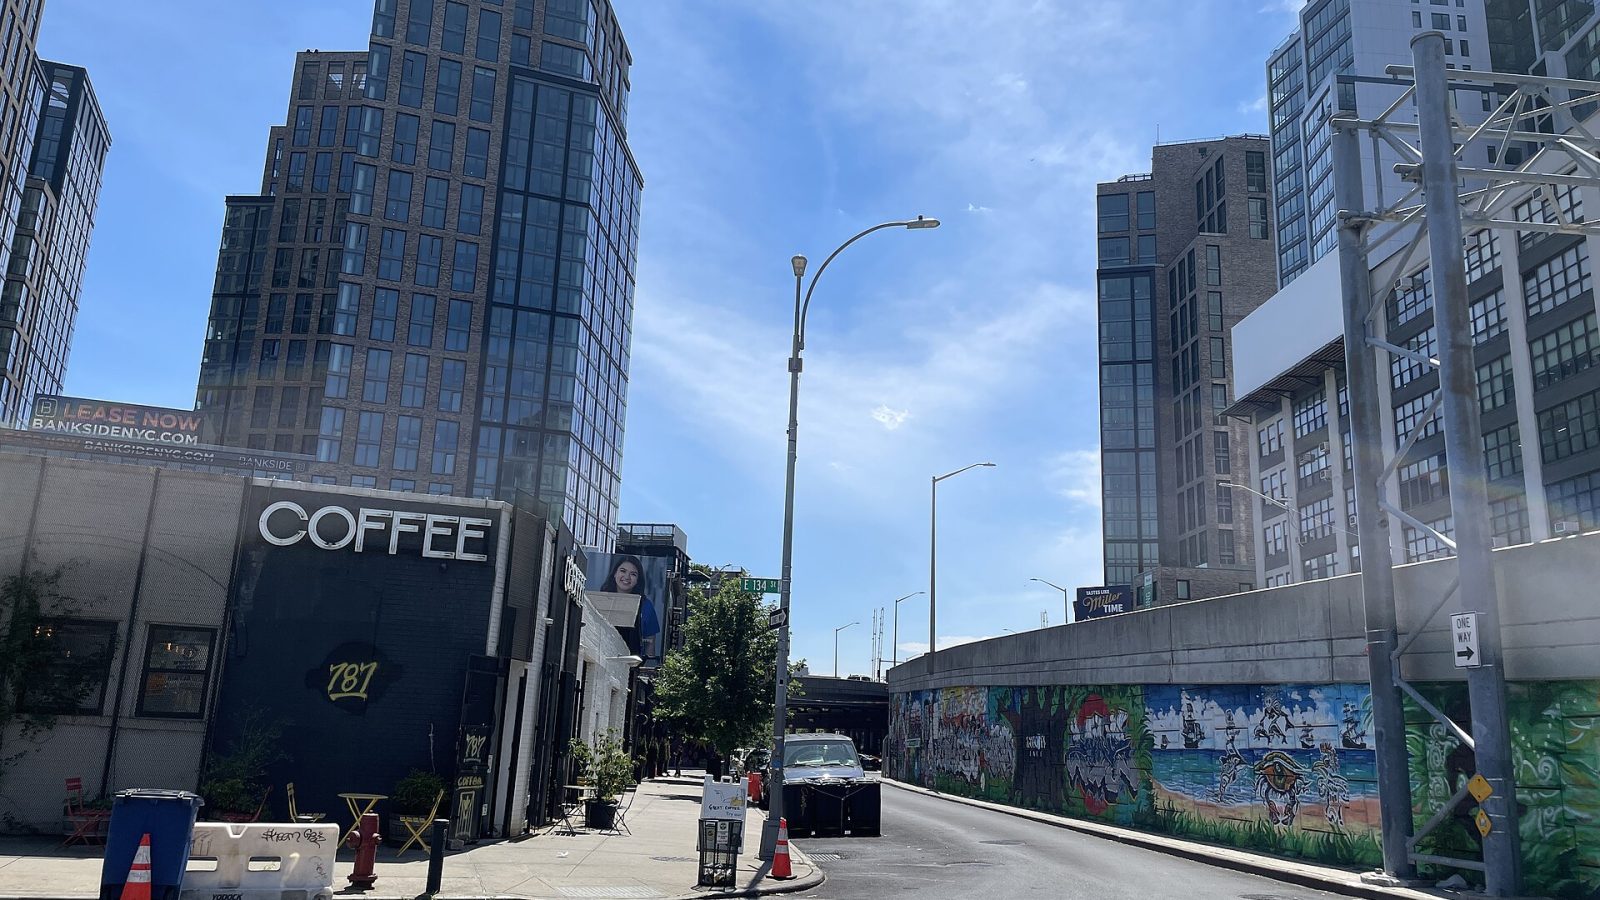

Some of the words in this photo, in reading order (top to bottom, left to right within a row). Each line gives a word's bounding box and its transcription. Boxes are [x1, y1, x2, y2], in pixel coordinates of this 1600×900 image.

[63, 402, 136, 425] LEASE
[143, 411, 201, 432] NOW
[32, 418, 198, 446] BANKSIDENYC.COM
[239, 456, 293, 471] BANKSIDE
[258, 501, 492, 562] COFFEE
[744, 579, 749, 590] E
[753, 579, 767, 591] 134
[1083, 592, 1122, 613] Miller
[1103, 603, 1124, 613] TIME
[1456, 617, 1471, 629] ONE
[1457, 631, 1471, 643] WAY
[328, 662, 378, 696] 787
